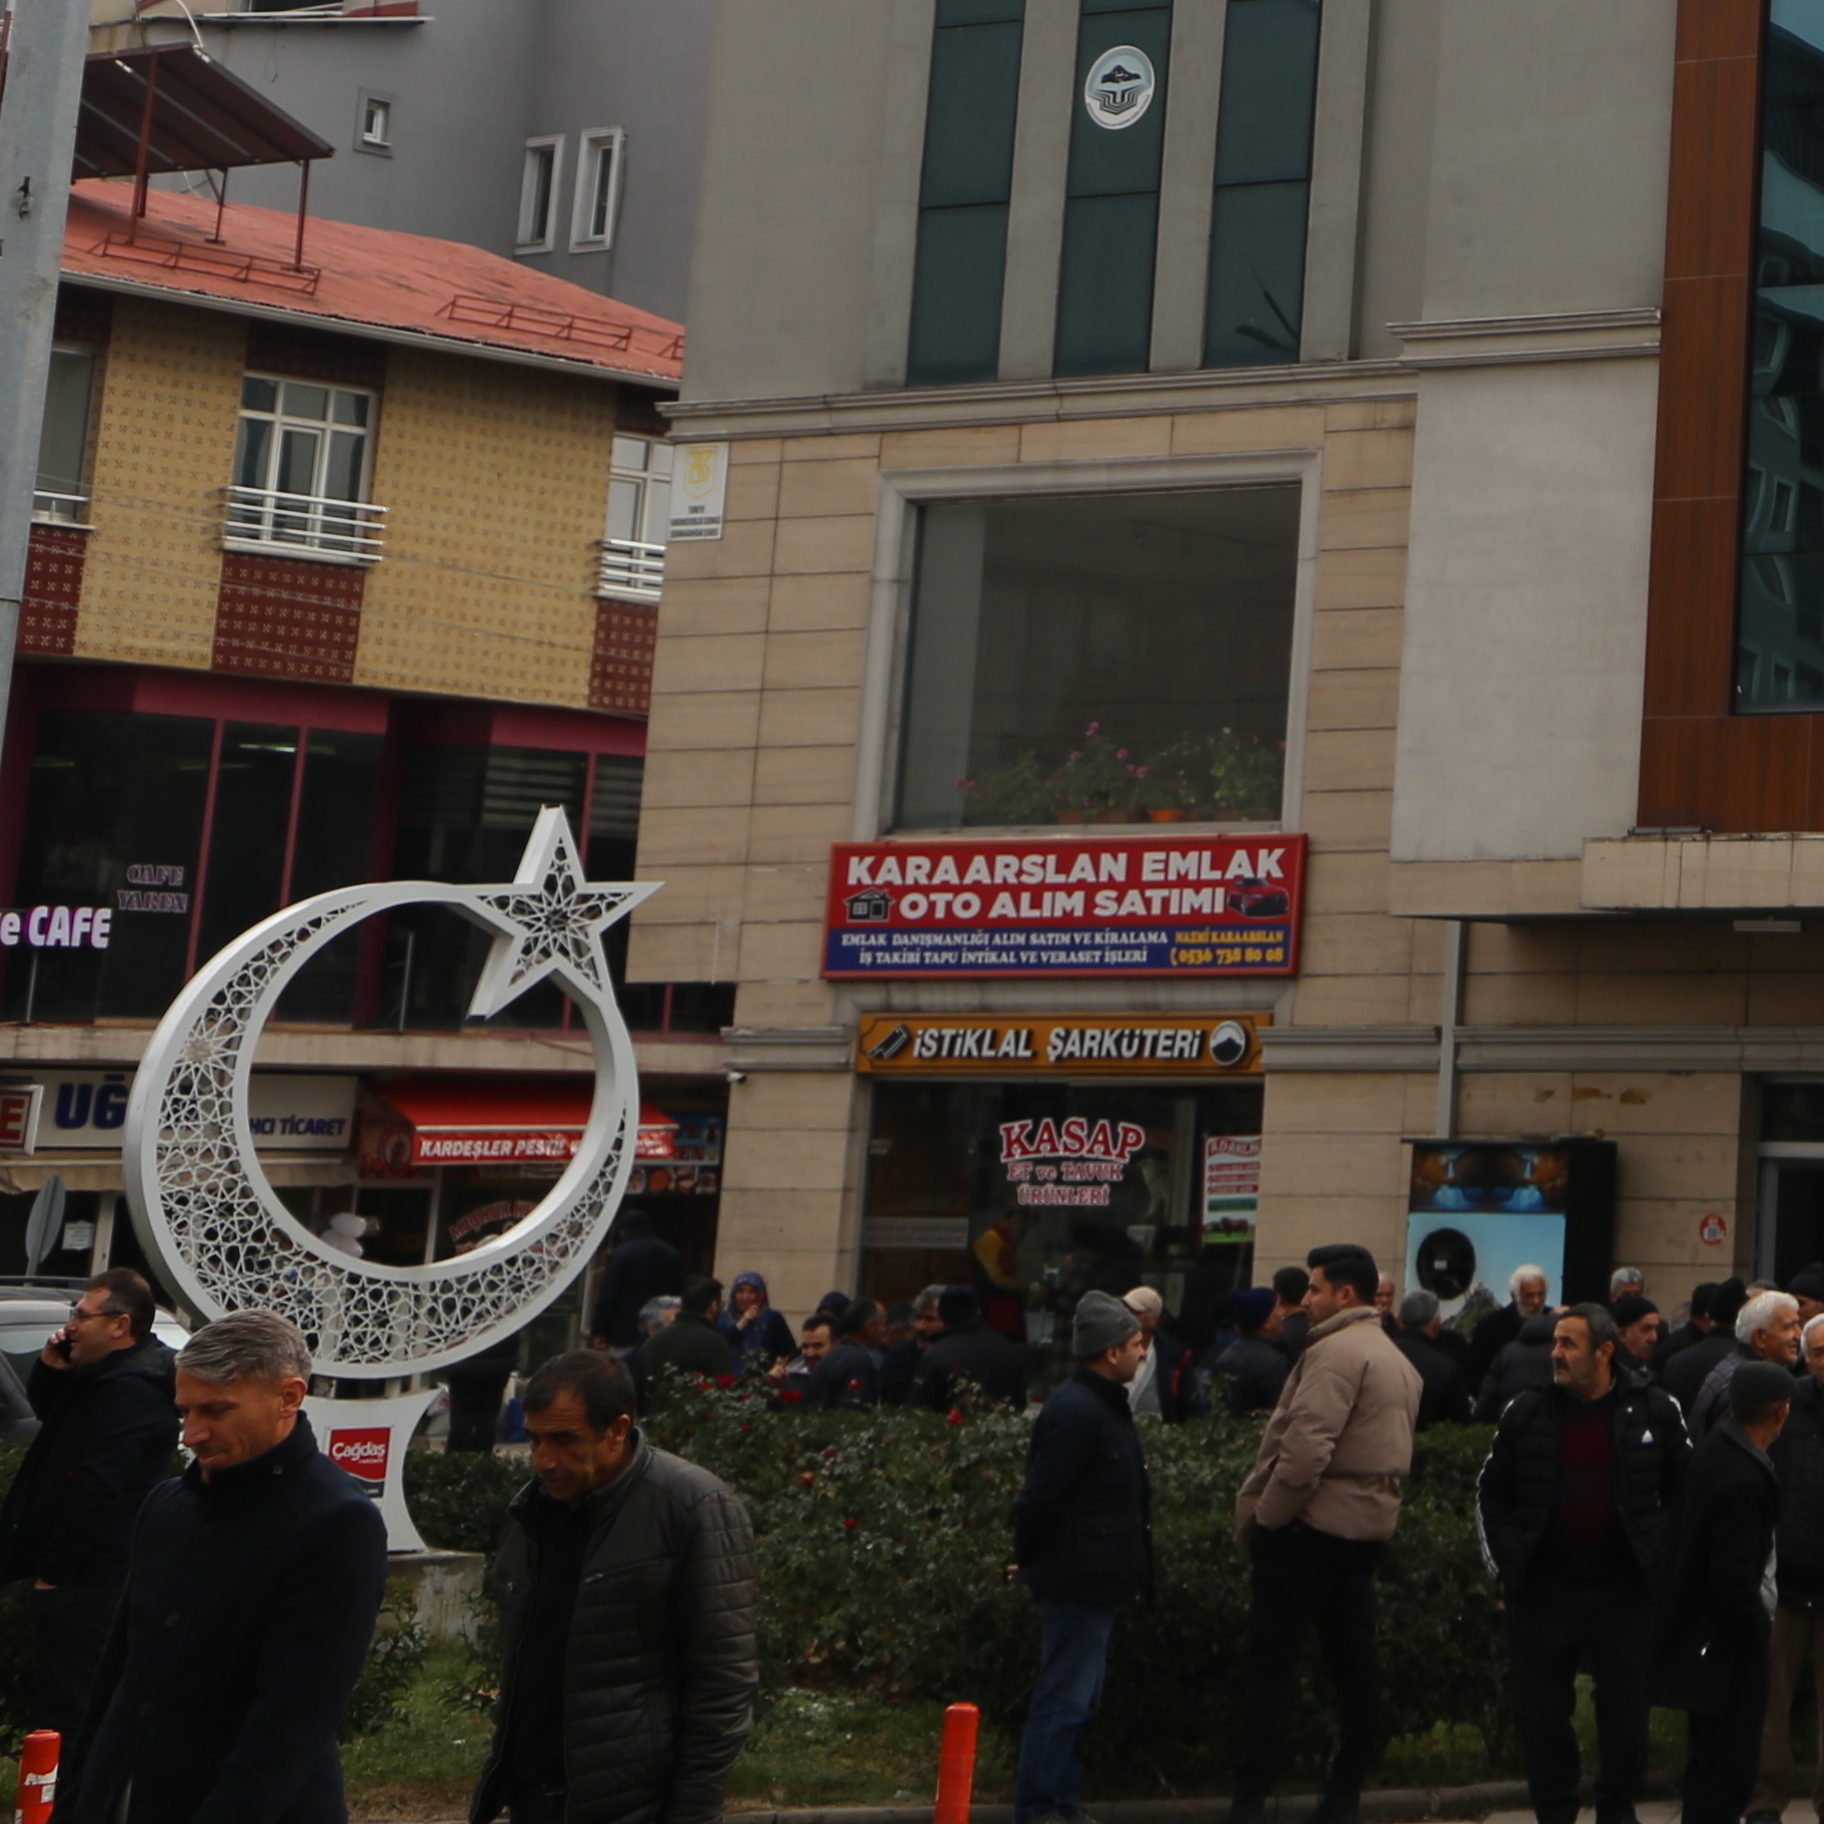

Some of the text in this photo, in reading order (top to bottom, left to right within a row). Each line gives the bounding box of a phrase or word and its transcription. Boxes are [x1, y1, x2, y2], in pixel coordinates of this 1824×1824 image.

[126, 863, 185, 887] CAFE
[847, 847, 1286, 887] KARAARSLAN EMLAK
[898, 887, 1226, 920] OTO ALIM SATIMI
[28, 904, 113, 949] CAFE
[841, 933, 888, 946] EMLAK
[892, 929, 990, 948] DANIŞMANLIĞI
[992, 932, 1026, 945] ALIM
[1029, 932, 1071, 945] SATIM
[1073, 931, 1091, 944] VE
[1094, 928, 1169, 944] KİRALAMA
[859, 946, 874, 965] İŞ
[875, 947, 921, 963] TAKİBİ
[923, 950, 959, 964] TAPU
[961, 946, 1017, 964] İNTİKAL
[1019, 950, 1038, 963] VE
[1040, 949, 1103, 964] VERASET
[1104, 946, 1148, 965] İŞLERİ
[912, 1027, 1201, 1062] İSTİKLAL ŞARKÜTERİ
[279, 1113, 347, 1136] TİCARET
[420, 1139, 511, 1160] KARDEŞLER
[999, 1116, 1146, 1164] KASAP
[1007, 1162, 1124, 1182] ET ve TAVUK
[1017, 1183, 1111, 1206] ÜRÜNLERİ
[332, 1441, 386, 1462] Çağdaş
